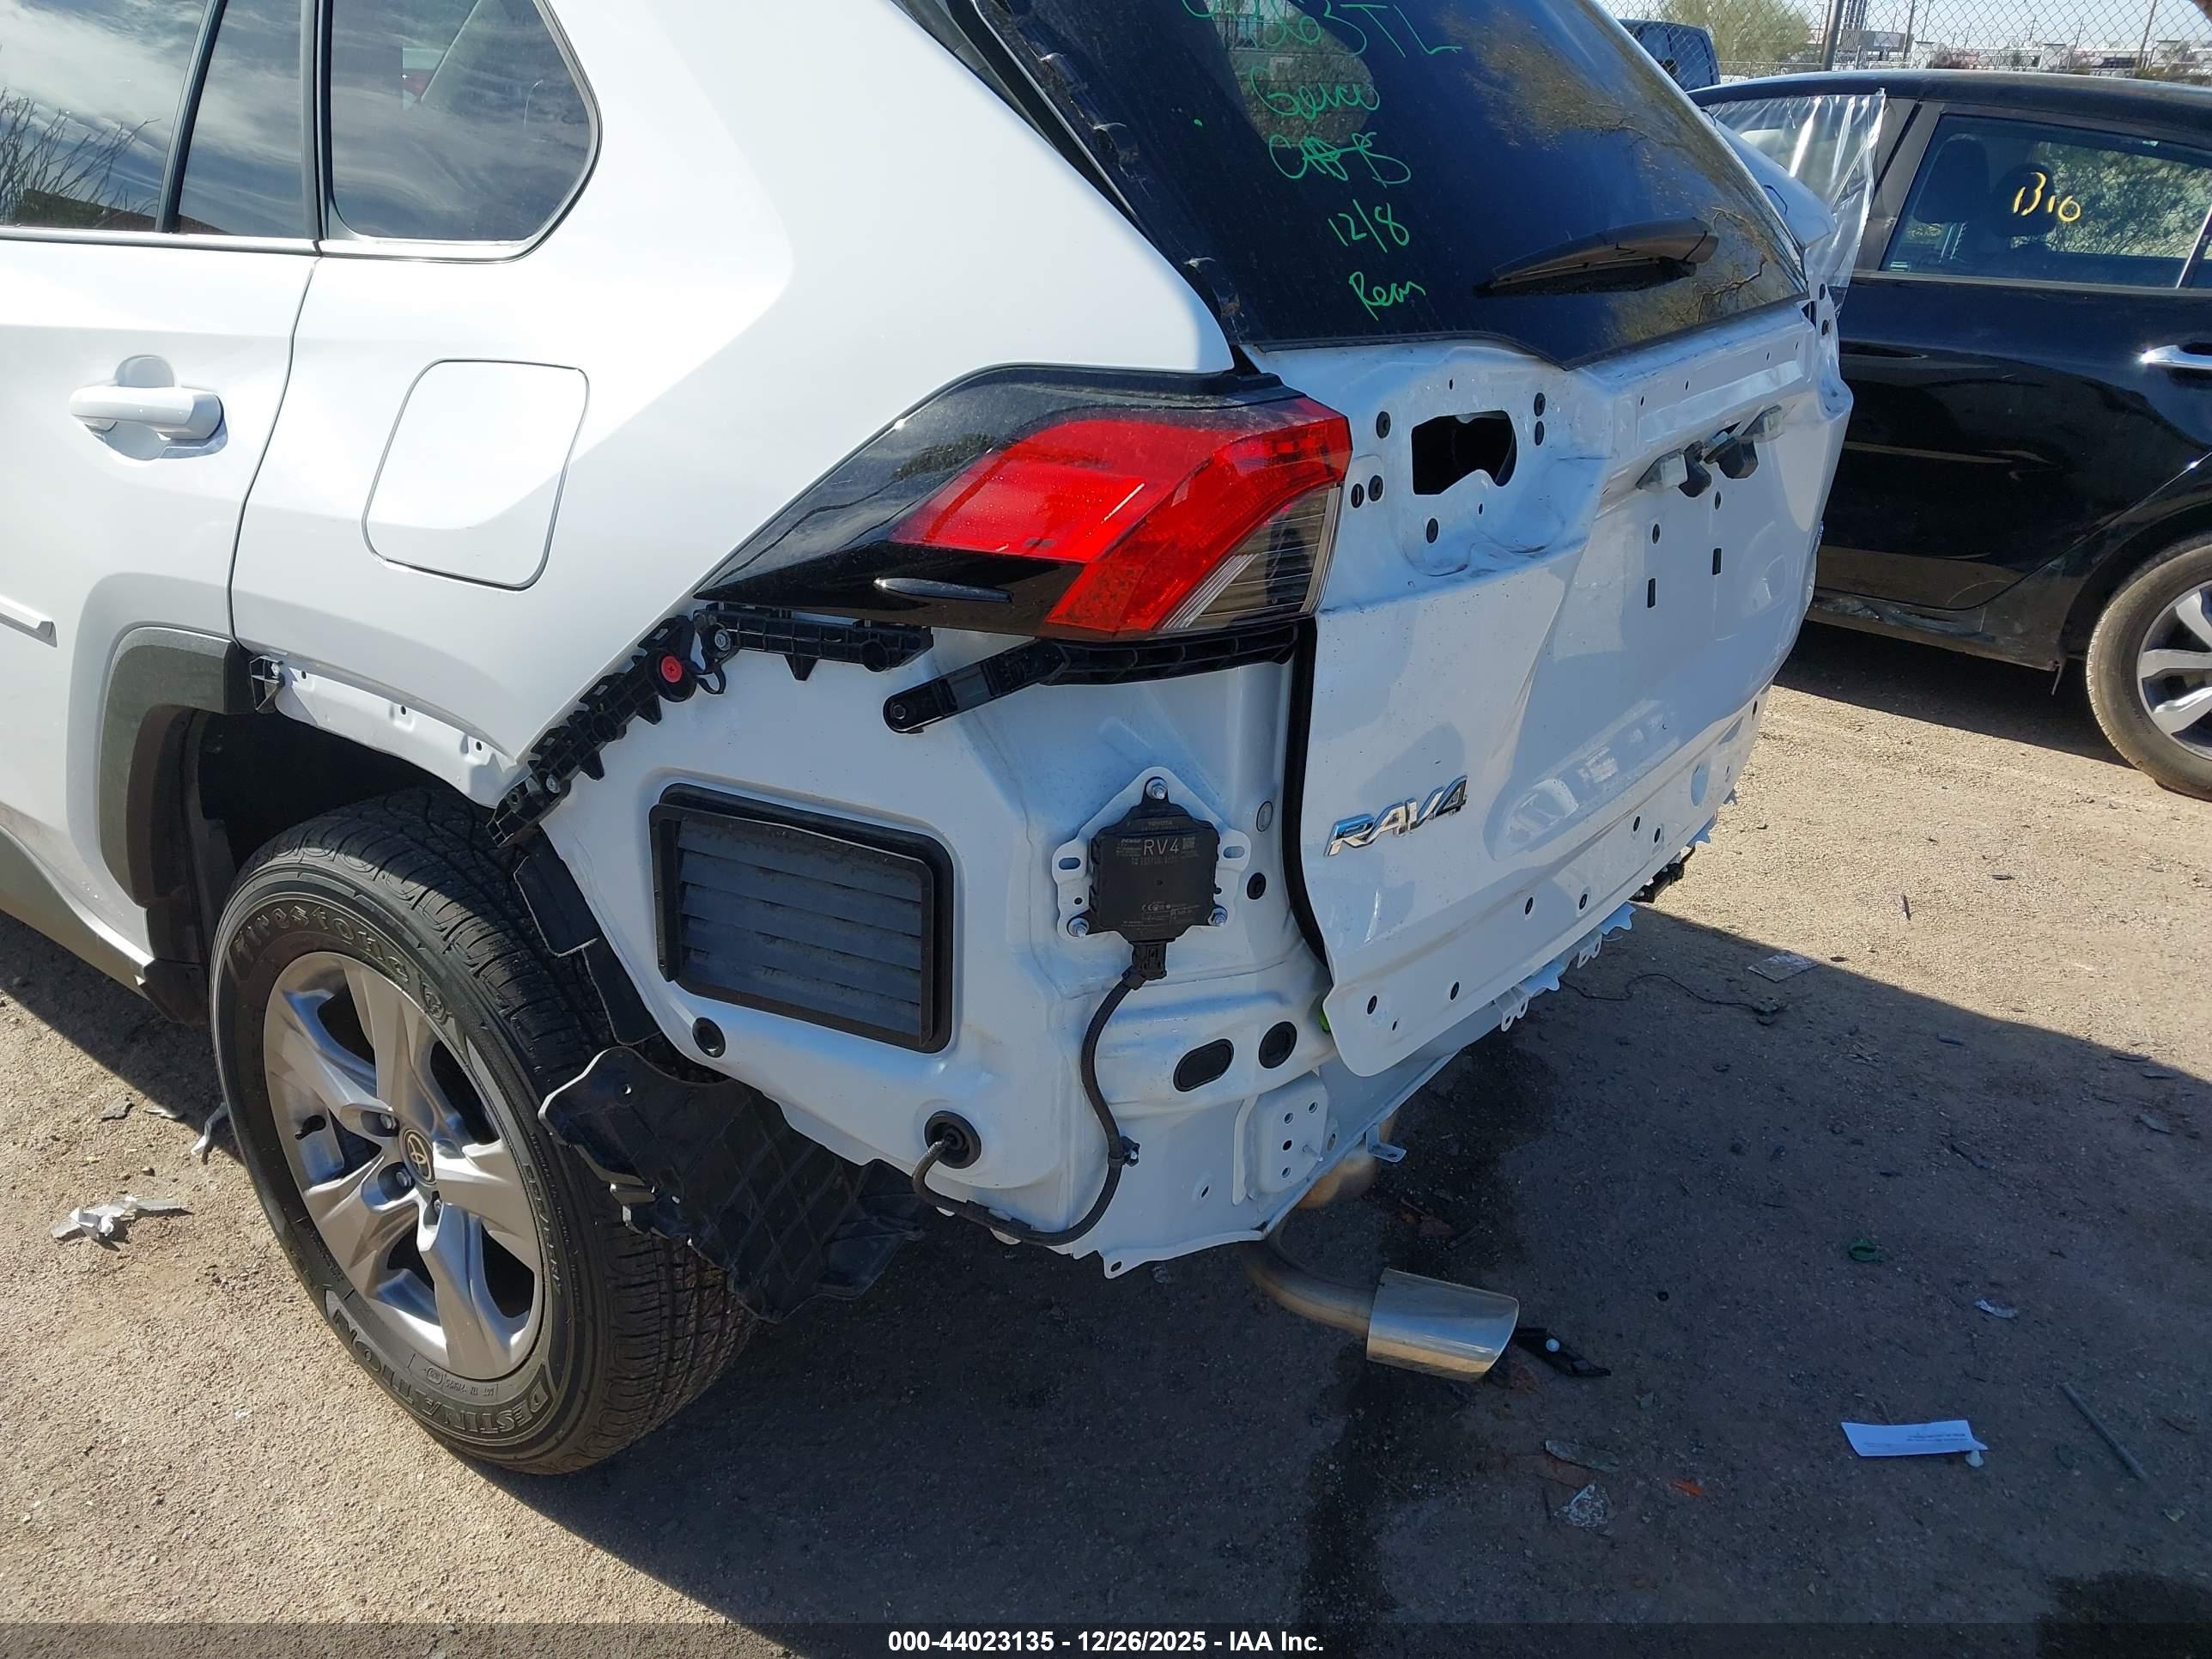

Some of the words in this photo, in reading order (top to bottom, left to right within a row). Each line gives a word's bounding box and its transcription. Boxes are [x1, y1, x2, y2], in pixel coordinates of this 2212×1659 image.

[1328, 199, 1409, 253] 12/8
[1143, 837, 1179, 855] RV4
[1323, 775, 1468, 857] RAV4
[332, 1310, 550, 1435] DESTINATION
